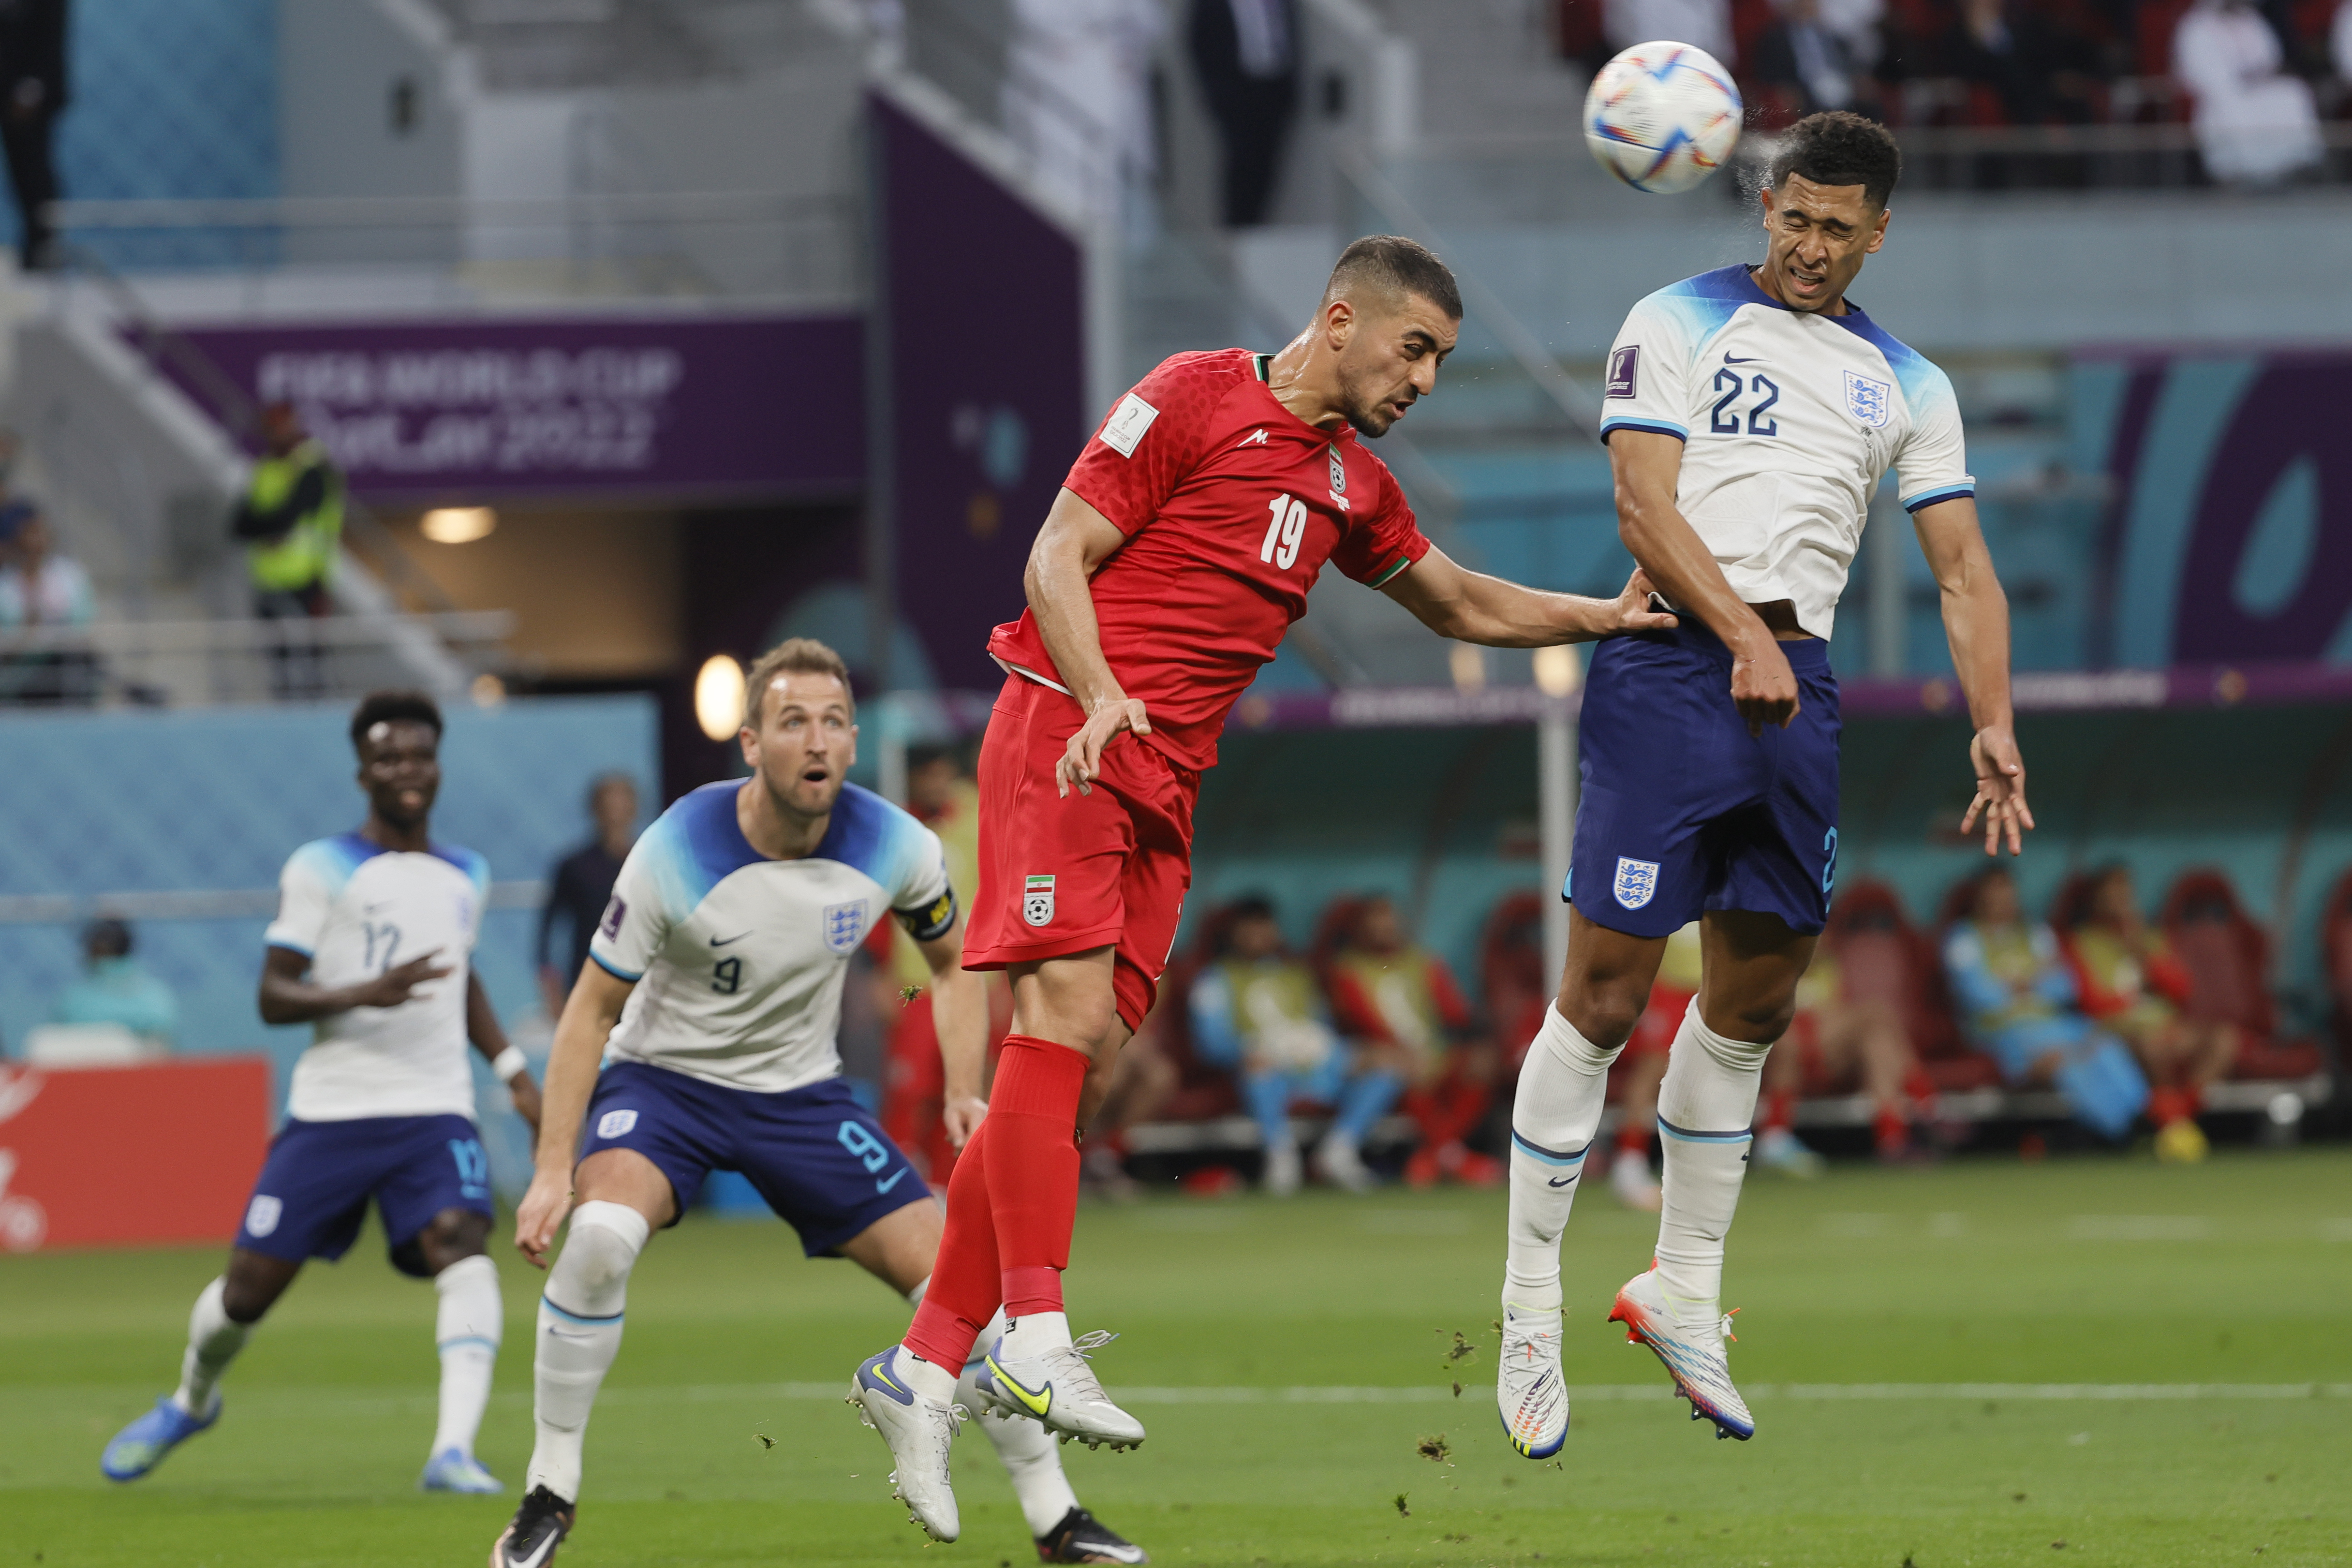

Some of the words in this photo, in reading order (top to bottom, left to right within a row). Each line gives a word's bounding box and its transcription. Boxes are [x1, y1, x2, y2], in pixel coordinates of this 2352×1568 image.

[1711, 367, 1778, 436] 22
[1260, 493, 1308, 570] 19
[712, 956, 742, 995] 9
[837, 1120, 889, 1174] 9
